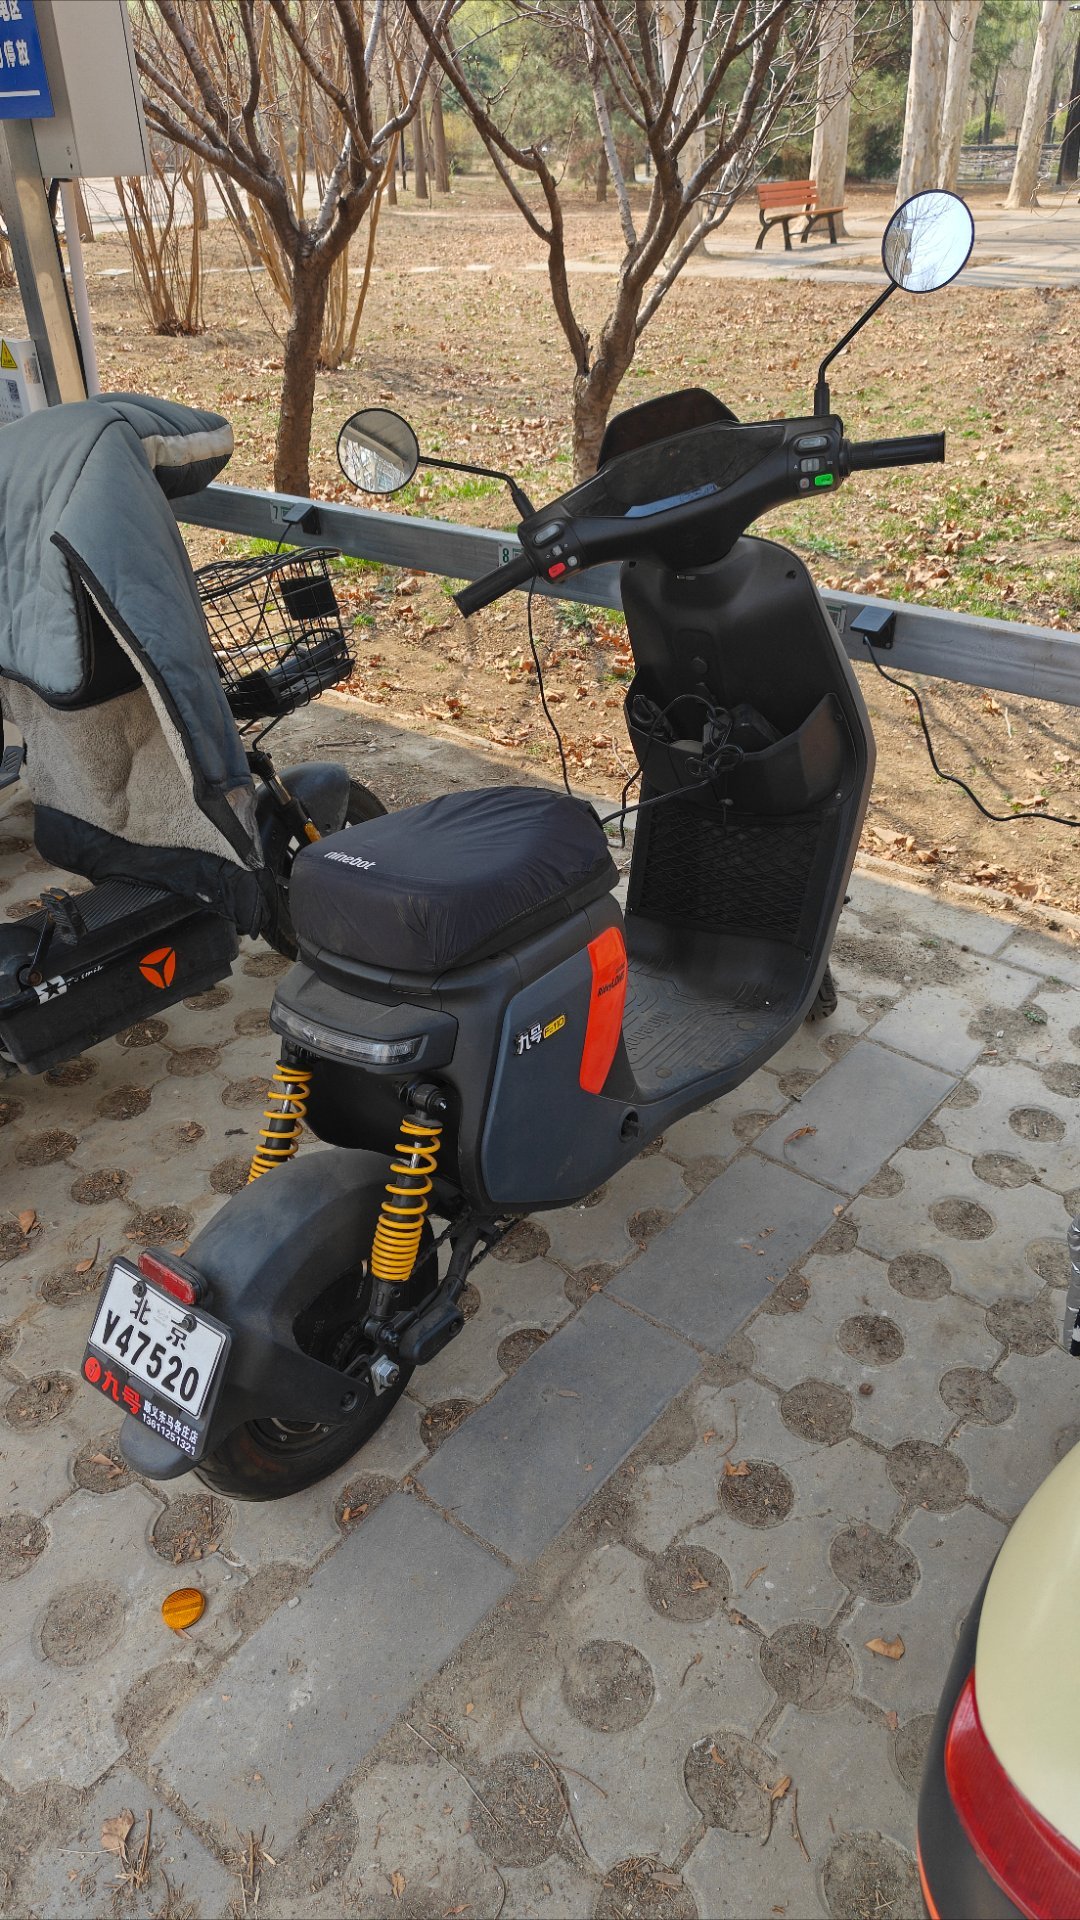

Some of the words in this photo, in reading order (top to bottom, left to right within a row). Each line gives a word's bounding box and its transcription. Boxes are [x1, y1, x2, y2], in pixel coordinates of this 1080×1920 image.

[0, 39, 30, 68] 停放
[272, 505, 279, 520] 7
[502, 547, 510, 563] 8
[323, 851, 377, 870] ninebot
[517, 1022, 542, 1055] 九号
[129, 1296, 192, 1351] 北京
[102, 1309, 200, 1402] V47520
[101, 1370, 143, 1415] 九号
[141, 1412, 197, 1457] 13611251321
[142, 1399, 199, 1446] 顺义东马各庄店
